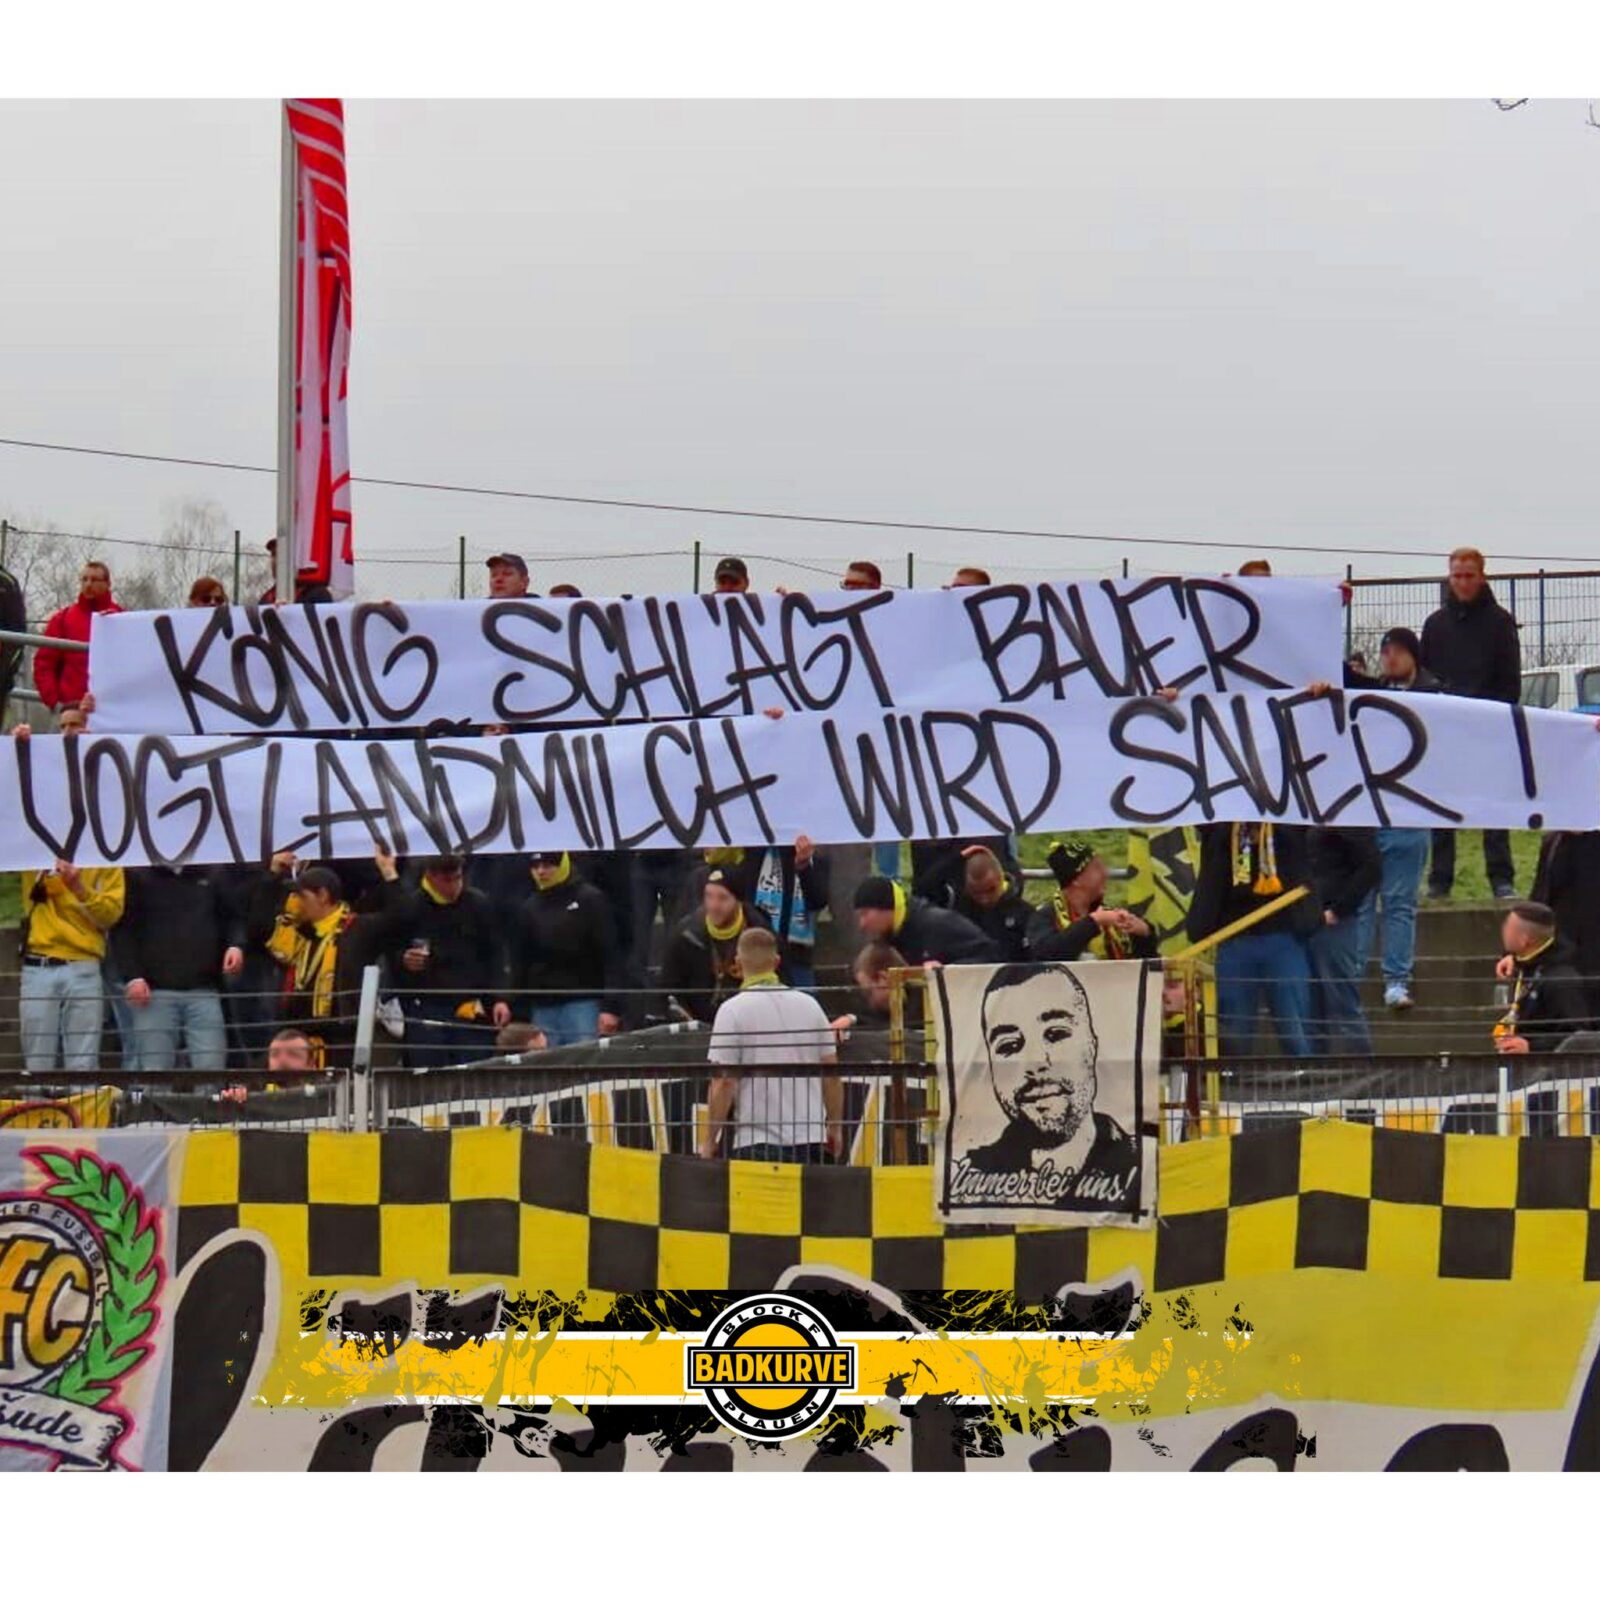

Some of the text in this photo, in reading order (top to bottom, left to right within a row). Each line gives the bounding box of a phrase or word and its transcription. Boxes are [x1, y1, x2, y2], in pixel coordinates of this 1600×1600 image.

[154, 576, 1294, 735] KÖNIG SCHLÄGT BAUER
[15, 718, 778, 868] VOGTLANDMILCH
[822, 709, 1061, 838] WIRD
[1109, 690, 1464, 828] SAUER
